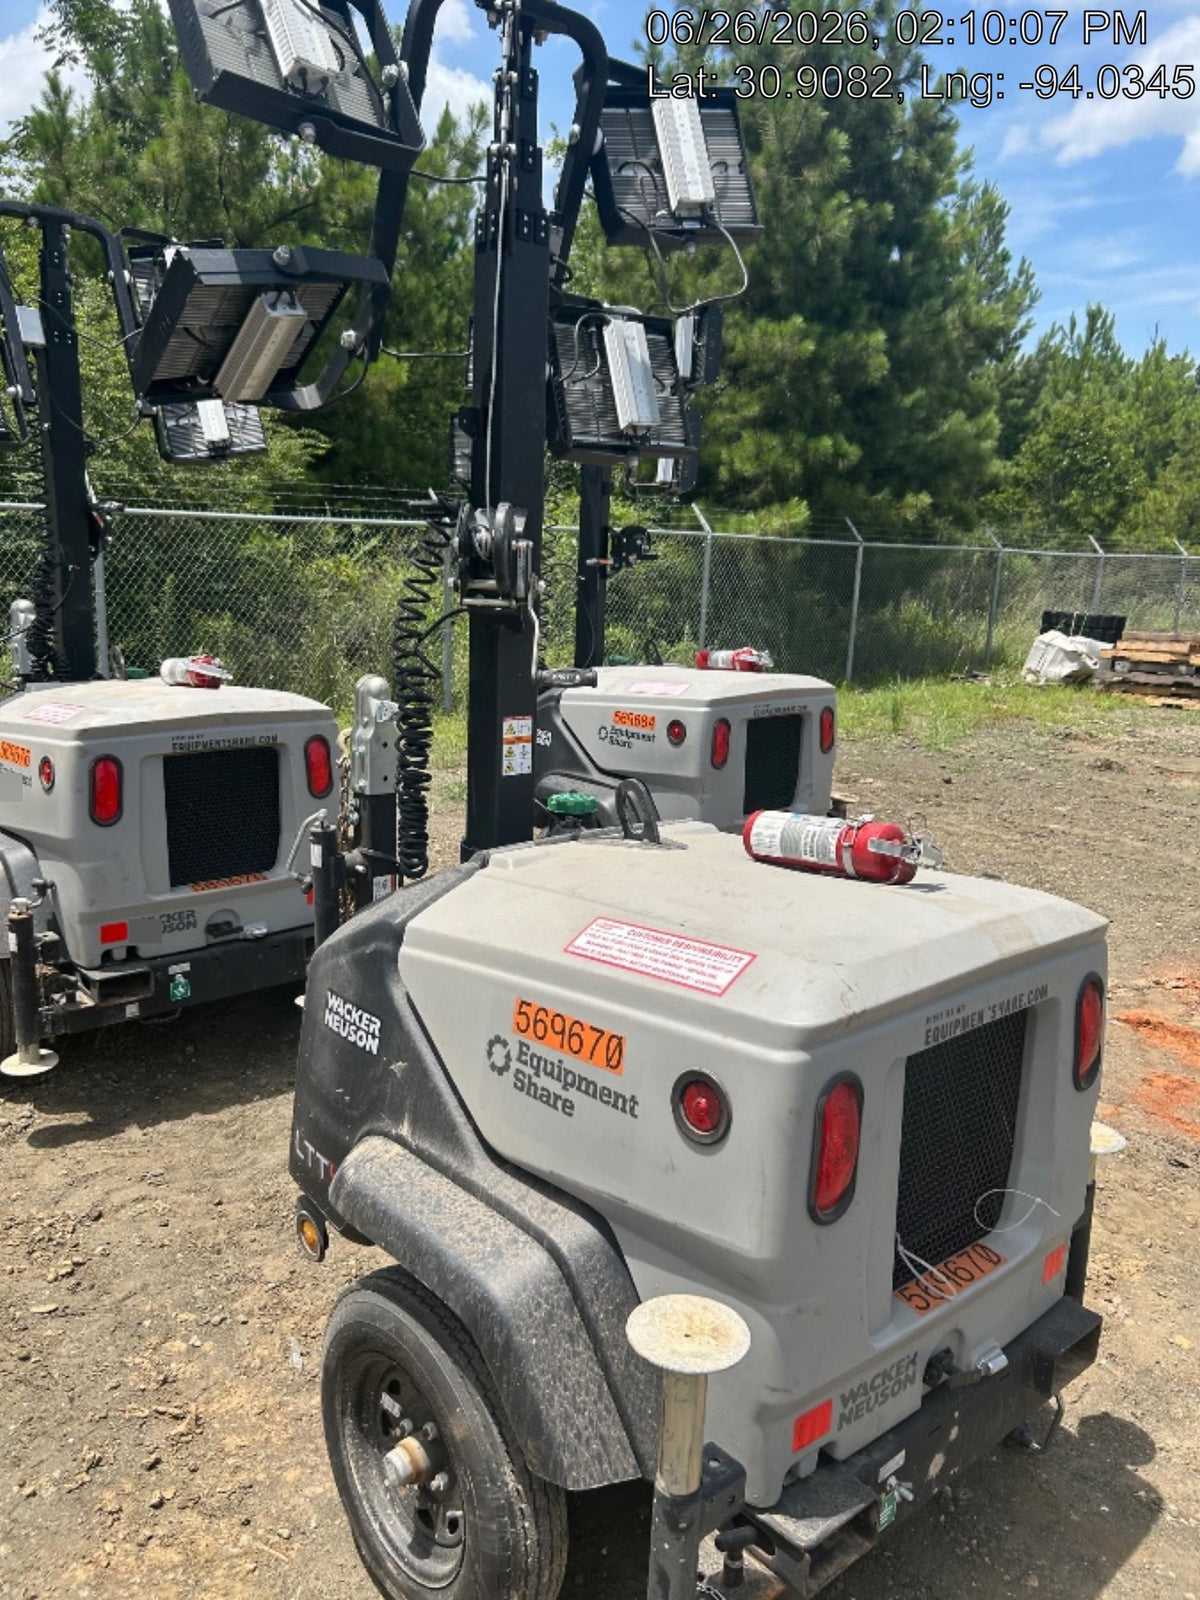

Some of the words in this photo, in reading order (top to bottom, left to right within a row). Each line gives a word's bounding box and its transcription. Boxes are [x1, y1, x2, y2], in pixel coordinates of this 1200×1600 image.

[324, 1009, 380, 1055] NEUSON
[327, 989, 381, 1037] WACKER
[515, 999, 624, 1070] 569670
[513, 1067, 576, 1117] Share
[516, 1039, 640, 1119] Equipment
[898, 1243, 1002, 1311] 569670
[837, 1370, 917, 1432] NEUSON
